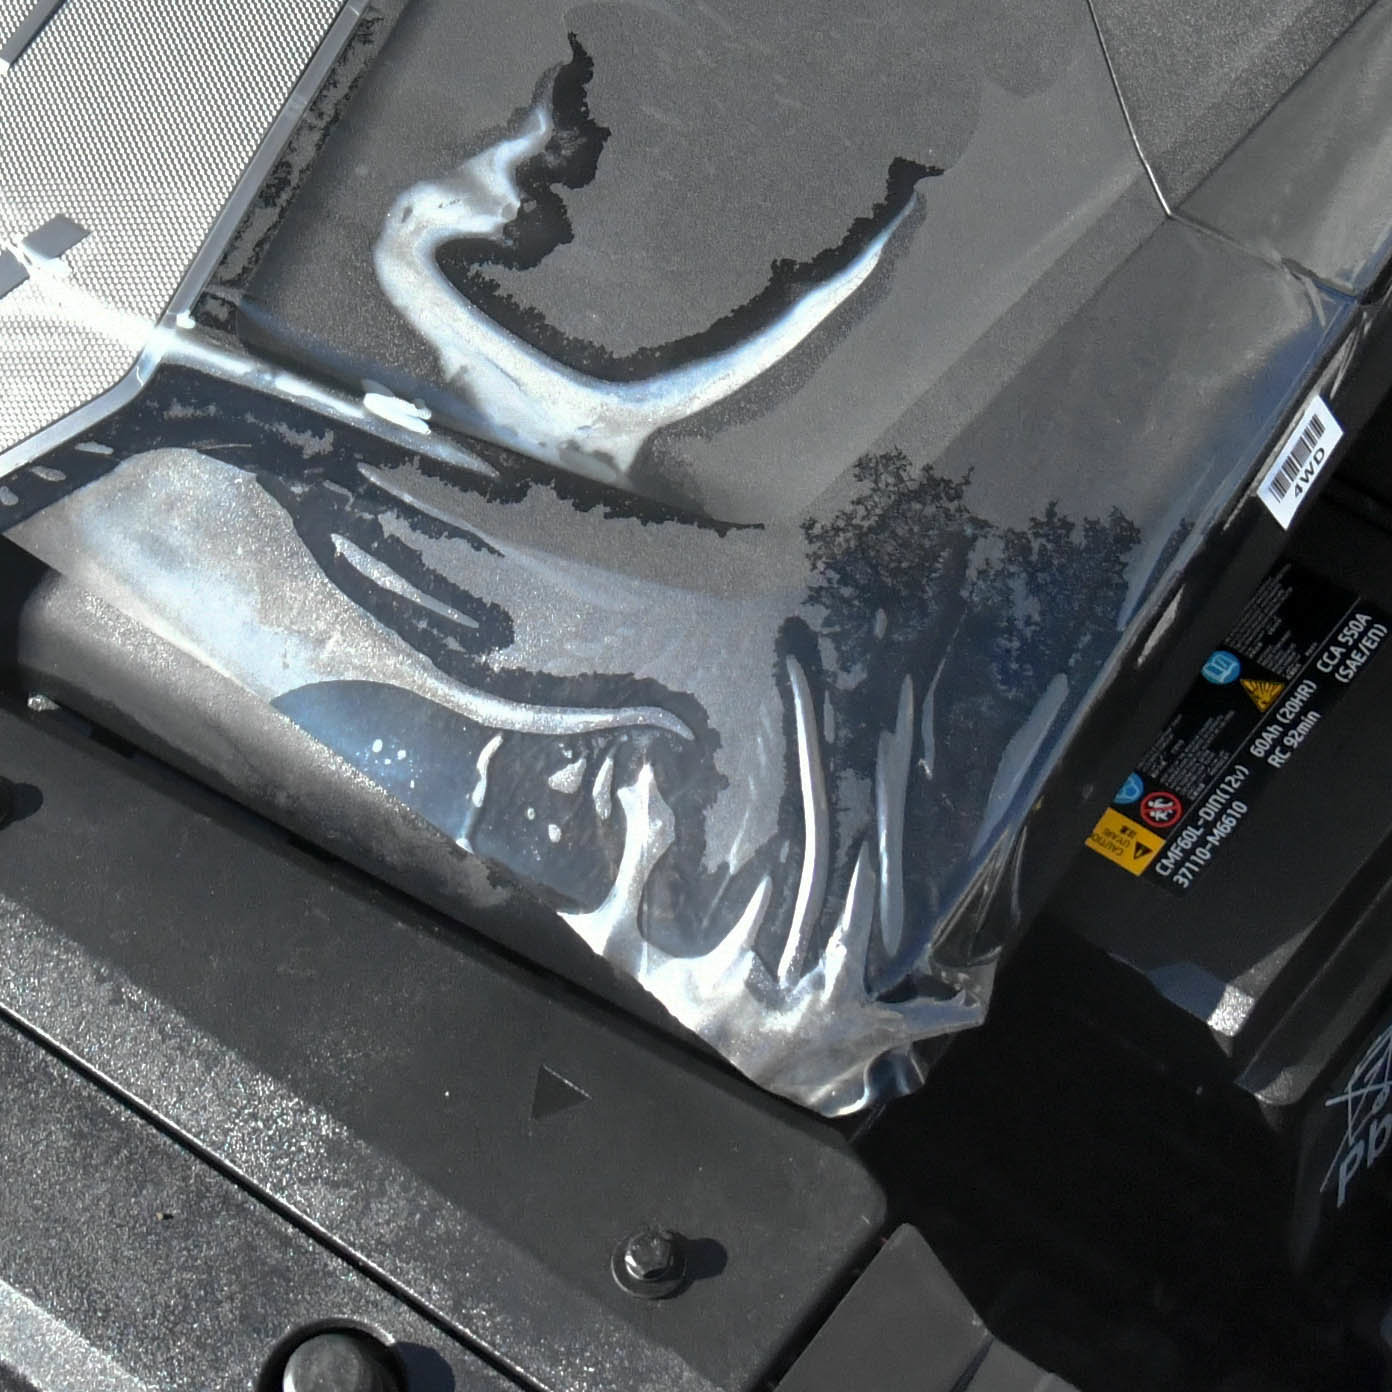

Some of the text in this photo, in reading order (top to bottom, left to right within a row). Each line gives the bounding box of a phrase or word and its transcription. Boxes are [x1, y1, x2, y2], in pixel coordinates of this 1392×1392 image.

[1294, 447, 1326, 498] 4WD
[1316, 612, 1372, 673] CCA 550A
[1249, 679, 1317, 758] 60Ah (20HR)
[1267, 710, 1321, 769] RC 92min
[1172, 800, 1248, 888] 37110-M6610
